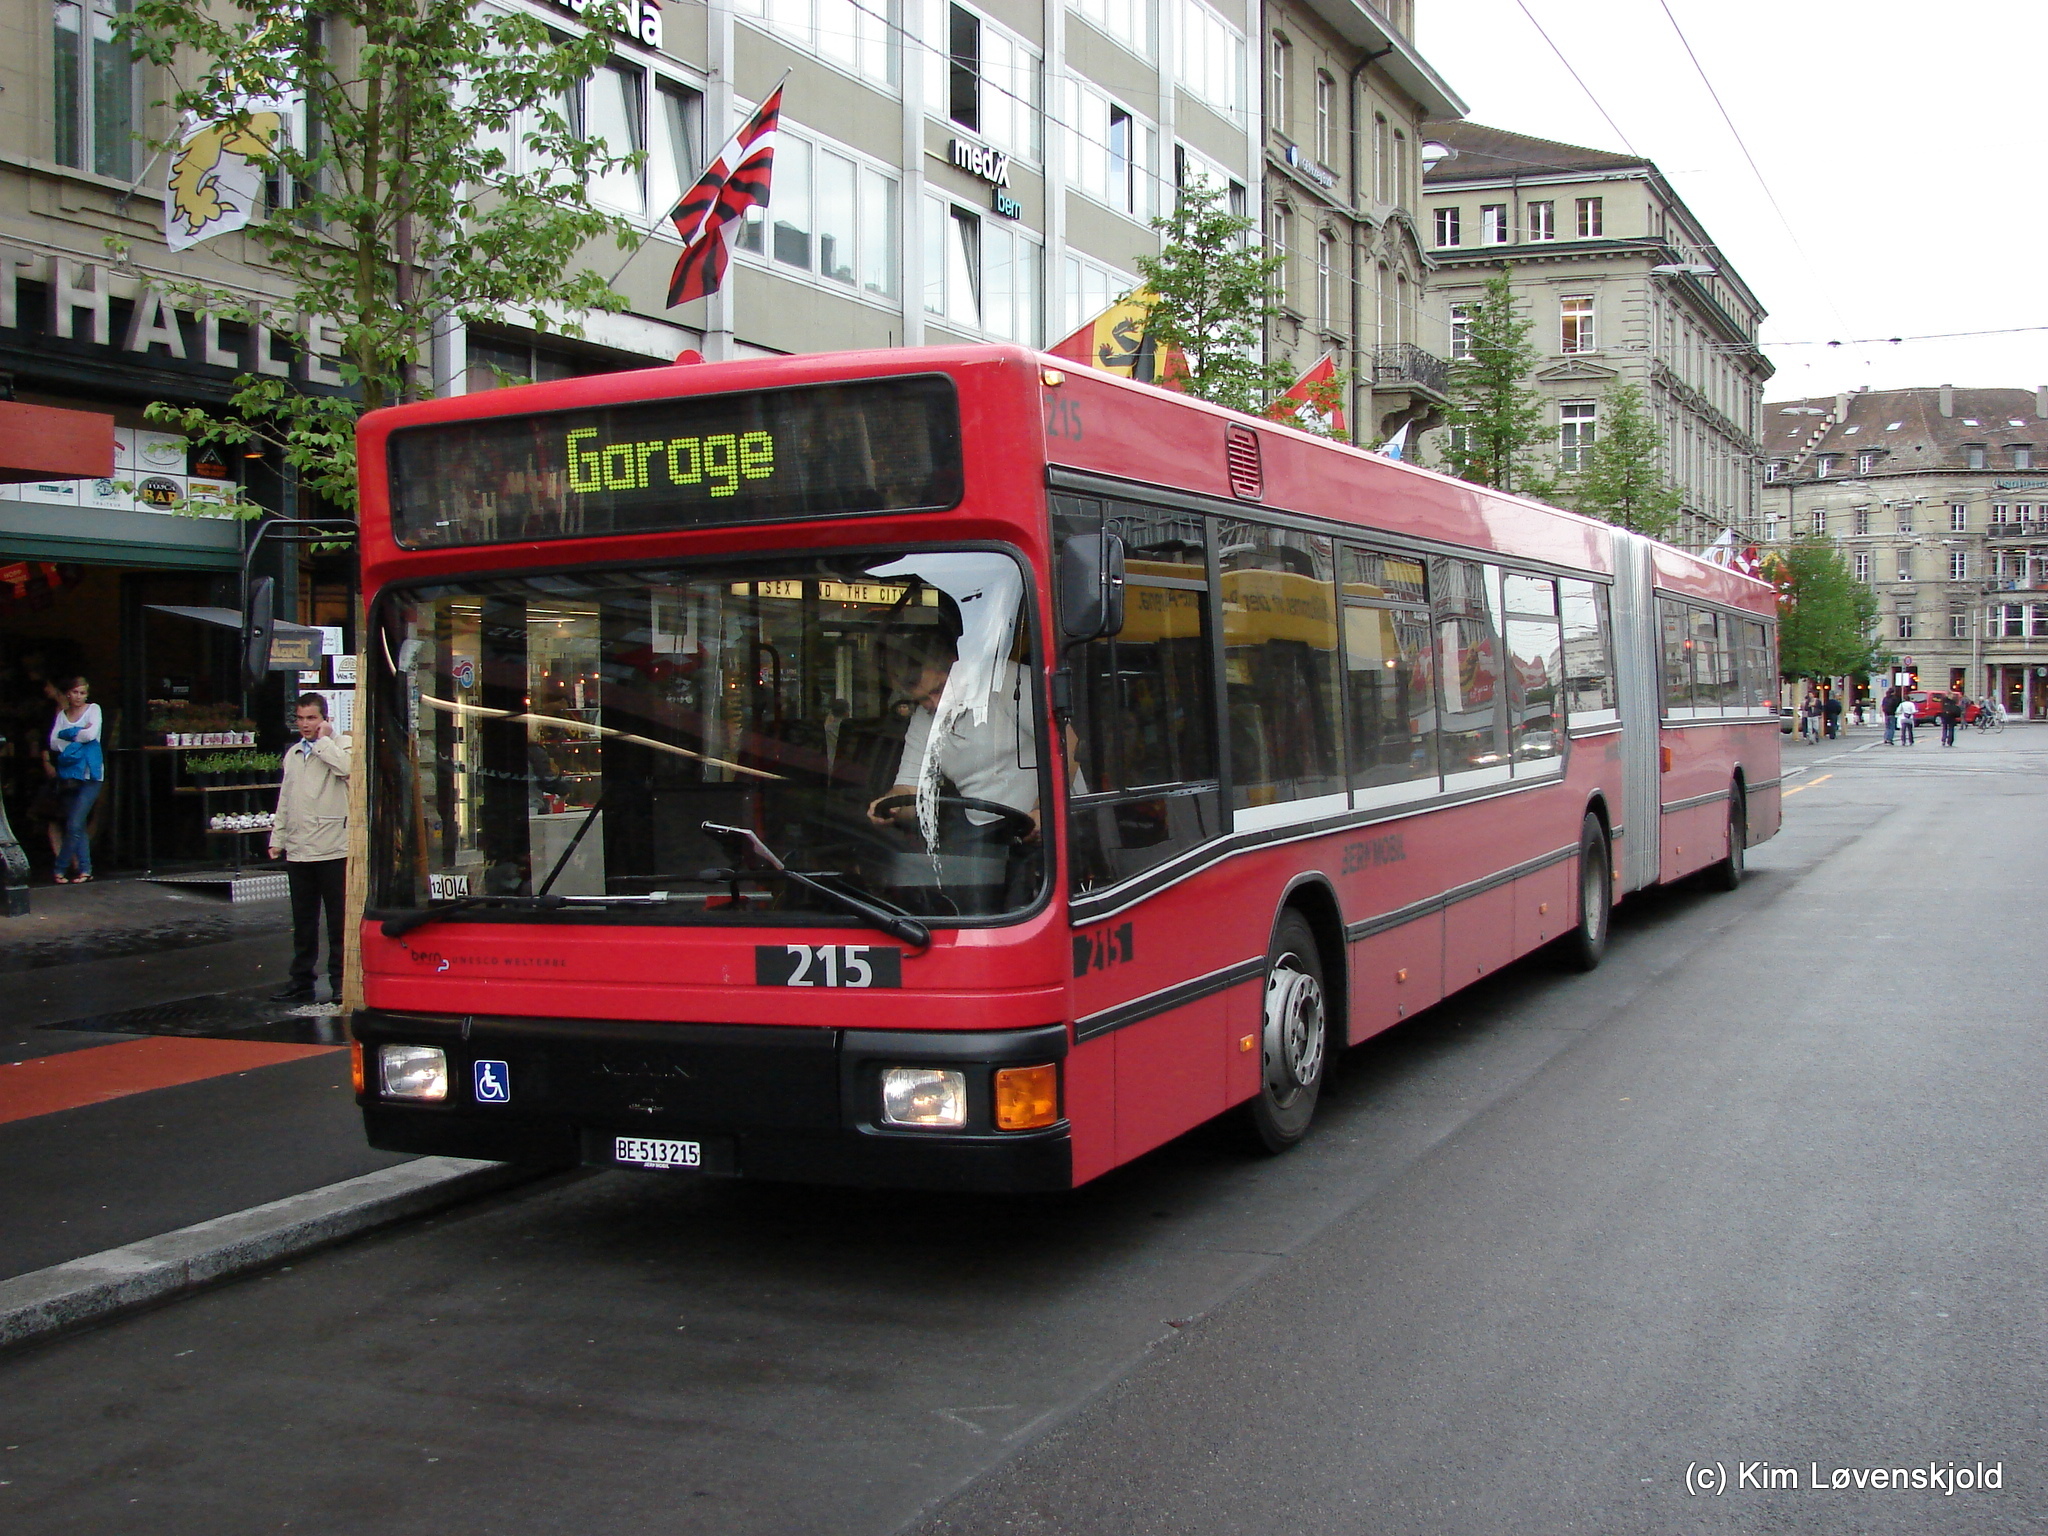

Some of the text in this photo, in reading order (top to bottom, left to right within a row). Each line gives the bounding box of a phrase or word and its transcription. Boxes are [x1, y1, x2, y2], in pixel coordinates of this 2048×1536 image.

[997, 187, 1022, 219] bern
[1045, 394, 1082, 441] 215
[567, 427, 774, 497] Garage
[765, 580, 791, 596] SEX
[847, 585, 868, 600] THE
[411, 949, 442, 962] bern
[451, 956, 499, 966] UNESCO
[786, 944, 873, 988] 215
